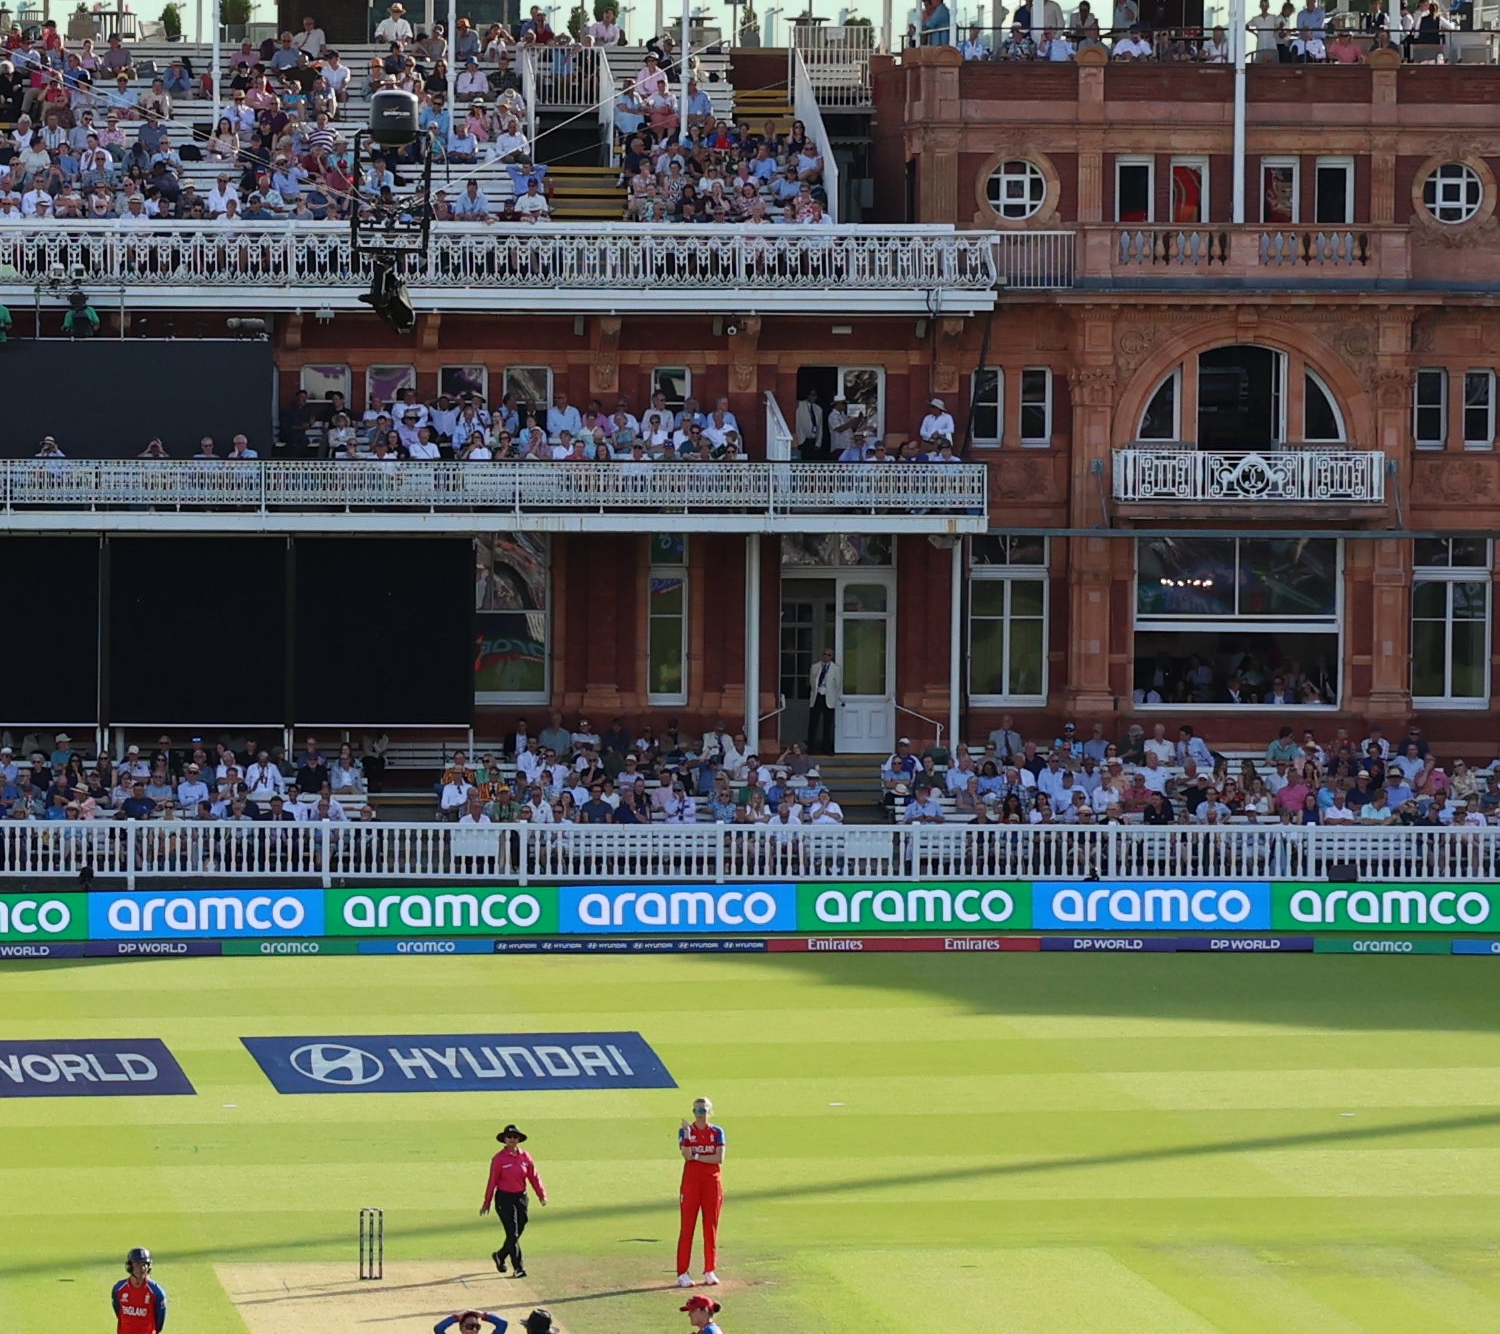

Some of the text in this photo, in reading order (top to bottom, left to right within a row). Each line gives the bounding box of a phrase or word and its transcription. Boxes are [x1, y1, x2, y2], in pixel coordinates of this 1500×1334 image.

[343, 894, 541, 928] aramco
[578, 891, 777, 926] aramco
[815, 889, 1014, 923] aramco
[1052, 889, 1251, 923] aramco
[1289, 889, 1490, 925] aramco
[108, 896, 305, 932] aramco
[118, 943, 188, 954] DP WORLD
[260, 942, 320, 954] aramco
[396, 941, 456, 953] aramco
[807, 938, 863, 951] Emirates
[944, 937, 1000, 950] Emirates
[1073, 939, 1143, 950] DP WORLD
[1210, 939, 1281, 950] DP WORLD
[1352, 940, 1413, 952] aramco
[1, 946, 50, 956] WORLD
[393, 1045, 634, 1078] HYUNDAI
